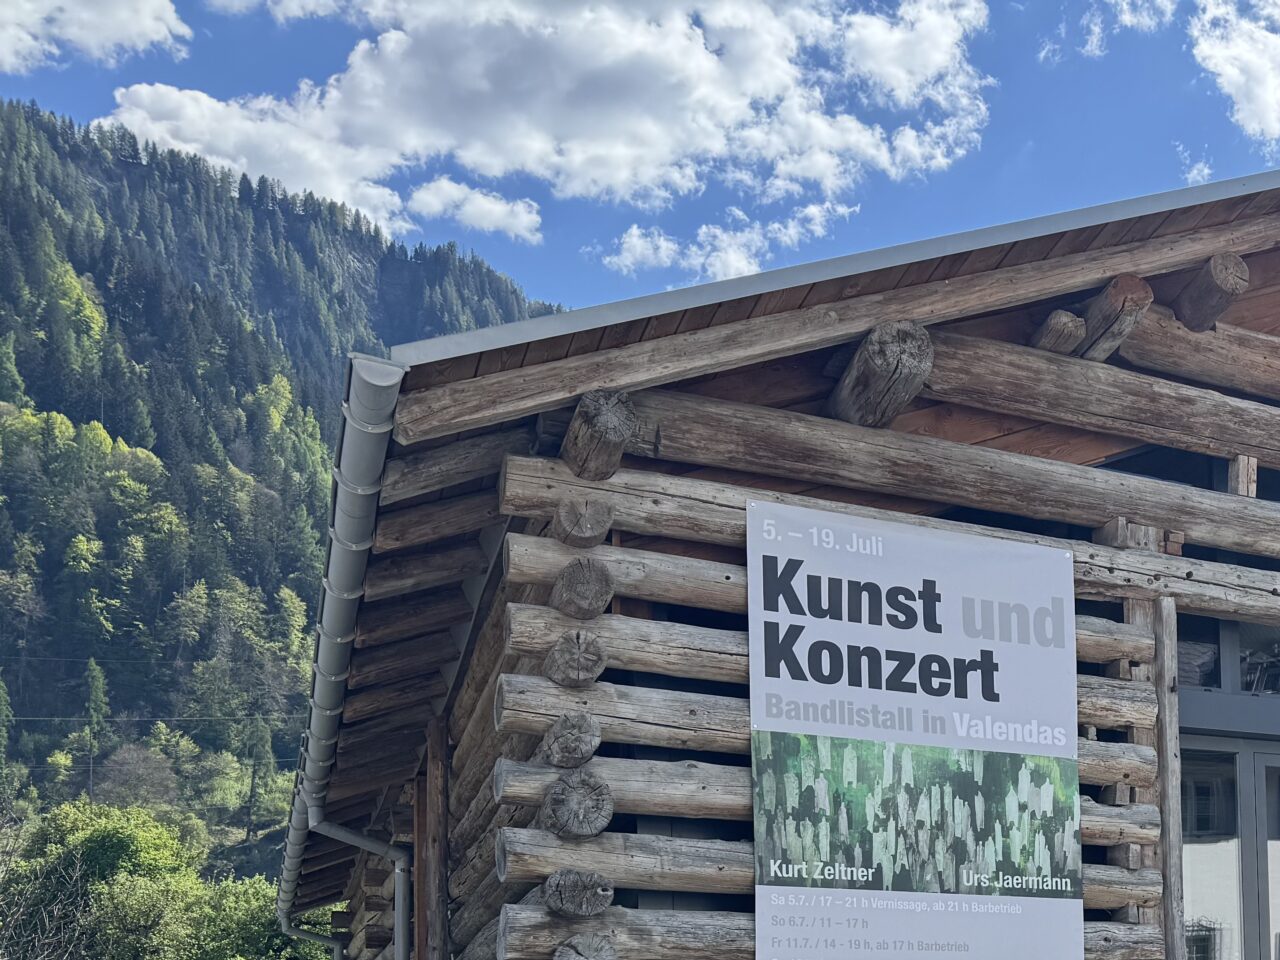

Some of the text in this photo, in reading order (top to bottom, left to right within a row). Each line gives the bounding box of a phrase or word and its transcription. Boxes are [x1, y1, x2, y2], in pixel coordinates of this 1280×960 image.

[762, 519, 782, 541] 5.
[809, 528, 840, 550] 19.
[846, 532, 883, 557] Juli
[762, 554, 1066, 649] Kunst und
[764, 621, 1000, 702] Konzert
[765, 692, 1066, 746] Bandlistall in Valendas
[770, 860, 875, 881] Kurt Zeltner
[963, 870, 1071, 890] Urs Jaermann
[771, 894, 785, 904] Sa
[789, 895, 808, 905] 5.7.
[820, 896, 832, 906] 17
[846, 897, 857, 907] 21
[862, 897, 868, 907] h
[871, 899, 930, 912] Vernissage,
[933, 901, 945, 911] ab
[948, 902, 958, 911] 21
[963, 902, 968, 912] h
[972, 903, 1022, 914] Barbetrieb
[771, 915, 785, 926] So
[789, 917, 808, 927] 6.7.
[820, 918, 831, 927] 11
[846, 918, 858, 928] 17
[862, 919, 868, 928] h
[772, 937, 782, 948] Fr
[786, 938, 812, 948] 11.7.
[824, 939, 836, 949] 14
[849, 940, 860, 949] 19
[864, 940, 872, 951] h,
[876, 940, 888, 950] ab
[893, 941, 904, 950] 17
[908, 941, 913, 950] h
[918, 941, 969, 952] Barbetrieb
